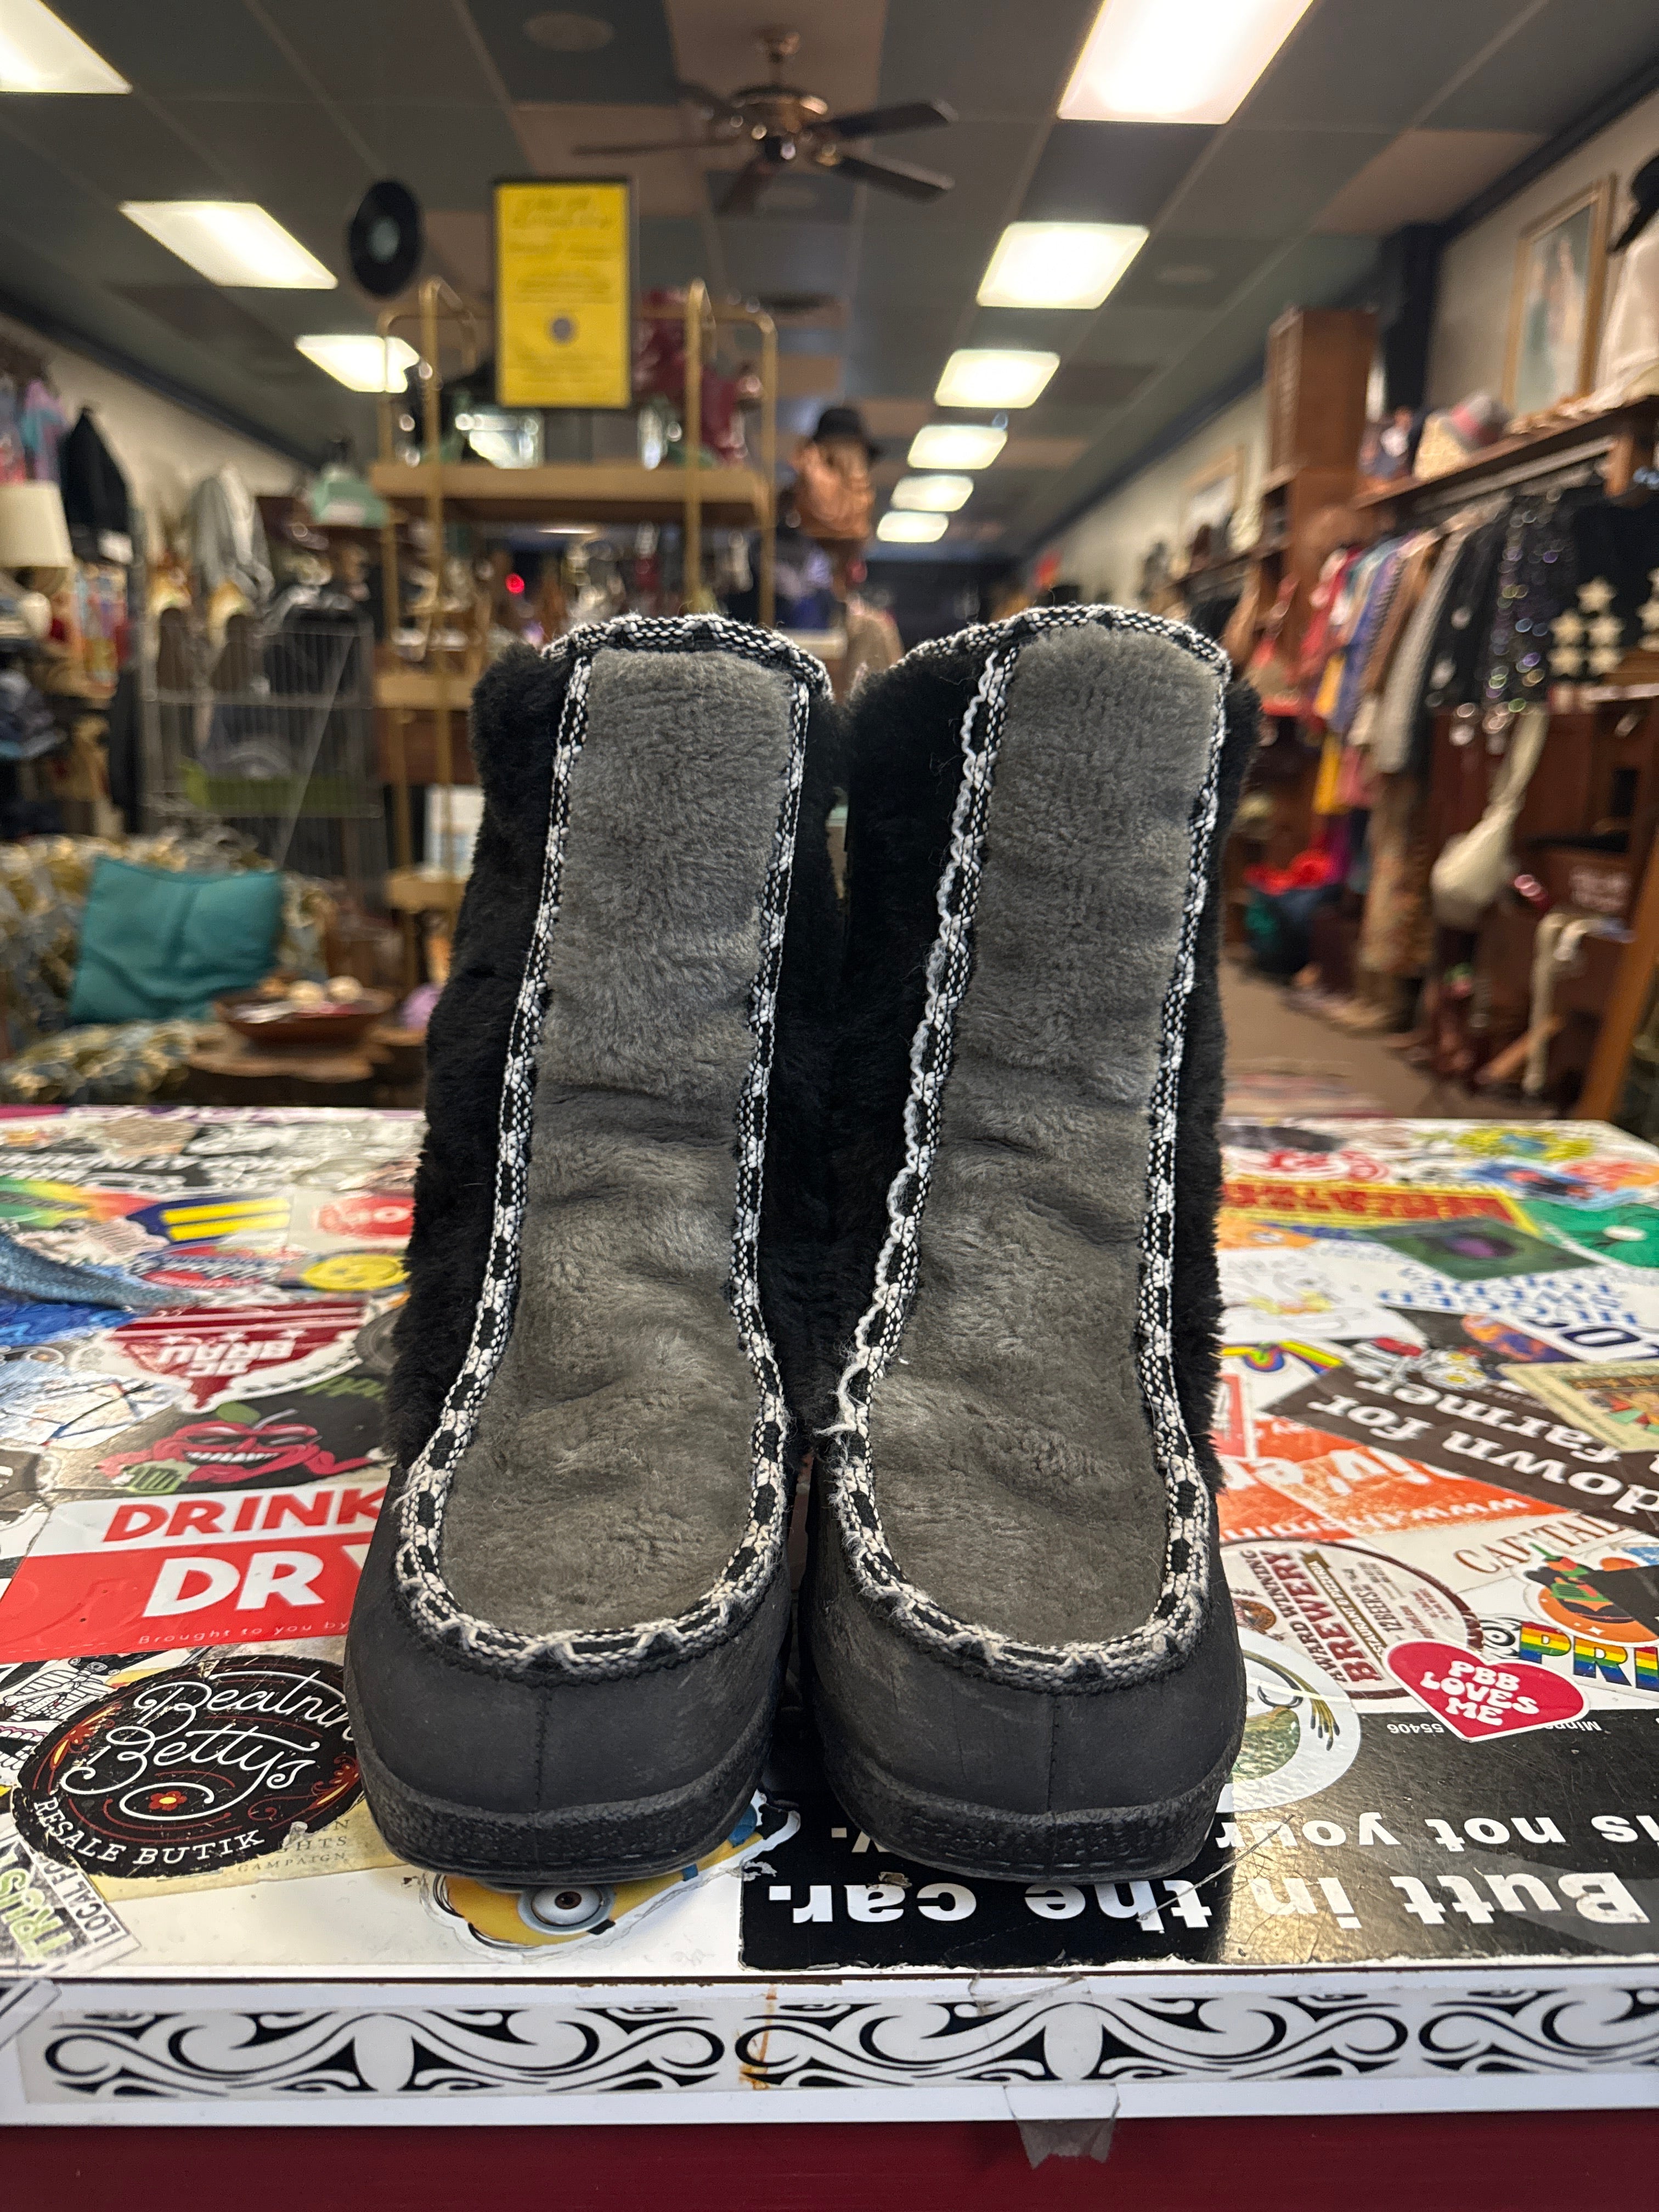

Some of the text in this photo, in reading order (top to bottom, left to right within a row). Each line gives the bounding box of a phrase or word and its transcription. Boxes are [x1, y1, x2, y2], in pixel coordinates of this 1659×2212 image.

[185, 1358, 250, 1377] DC
[1307, 1395, 1435, 1441] for
[1355, 1378, 1621, 1464] farmer
[1442, 1430, 1659, 1515] down
[103, 1485, 387, 1543] DRINK
[1454, 1514, 1626, 1574] CAPTAL
[138, 1620, 349, 1646] Brought to you by
[1239, 1549, 1348, 1683] AWARD WINNING
[1259, 1549, 1385, 1683] BREWERY
[1420, 1671, 1539, 1714] LOVES
[1448, 1660, 1520, 1691] PBB
[132, 1670, 354, 1740] Beatni
[1387, 1723, 1444, 1734] 55406
[1444, 1697, 1503, 1726] ME
[60, 1723, 320, 1821] Betty's
[33, 1797, 127, 1862] RESALE
[132, 1829, 265, 1865] BUTIK
[1215, 1812, 1401, 1849] your
[1424, 1817, 1567, 1852] not
[238, 1852, 347, 1872] CAMPAIGN
[63, 1879, 121, 1943] LOCAL
[769, 1872, 1651, 1932] Butt in the car.
